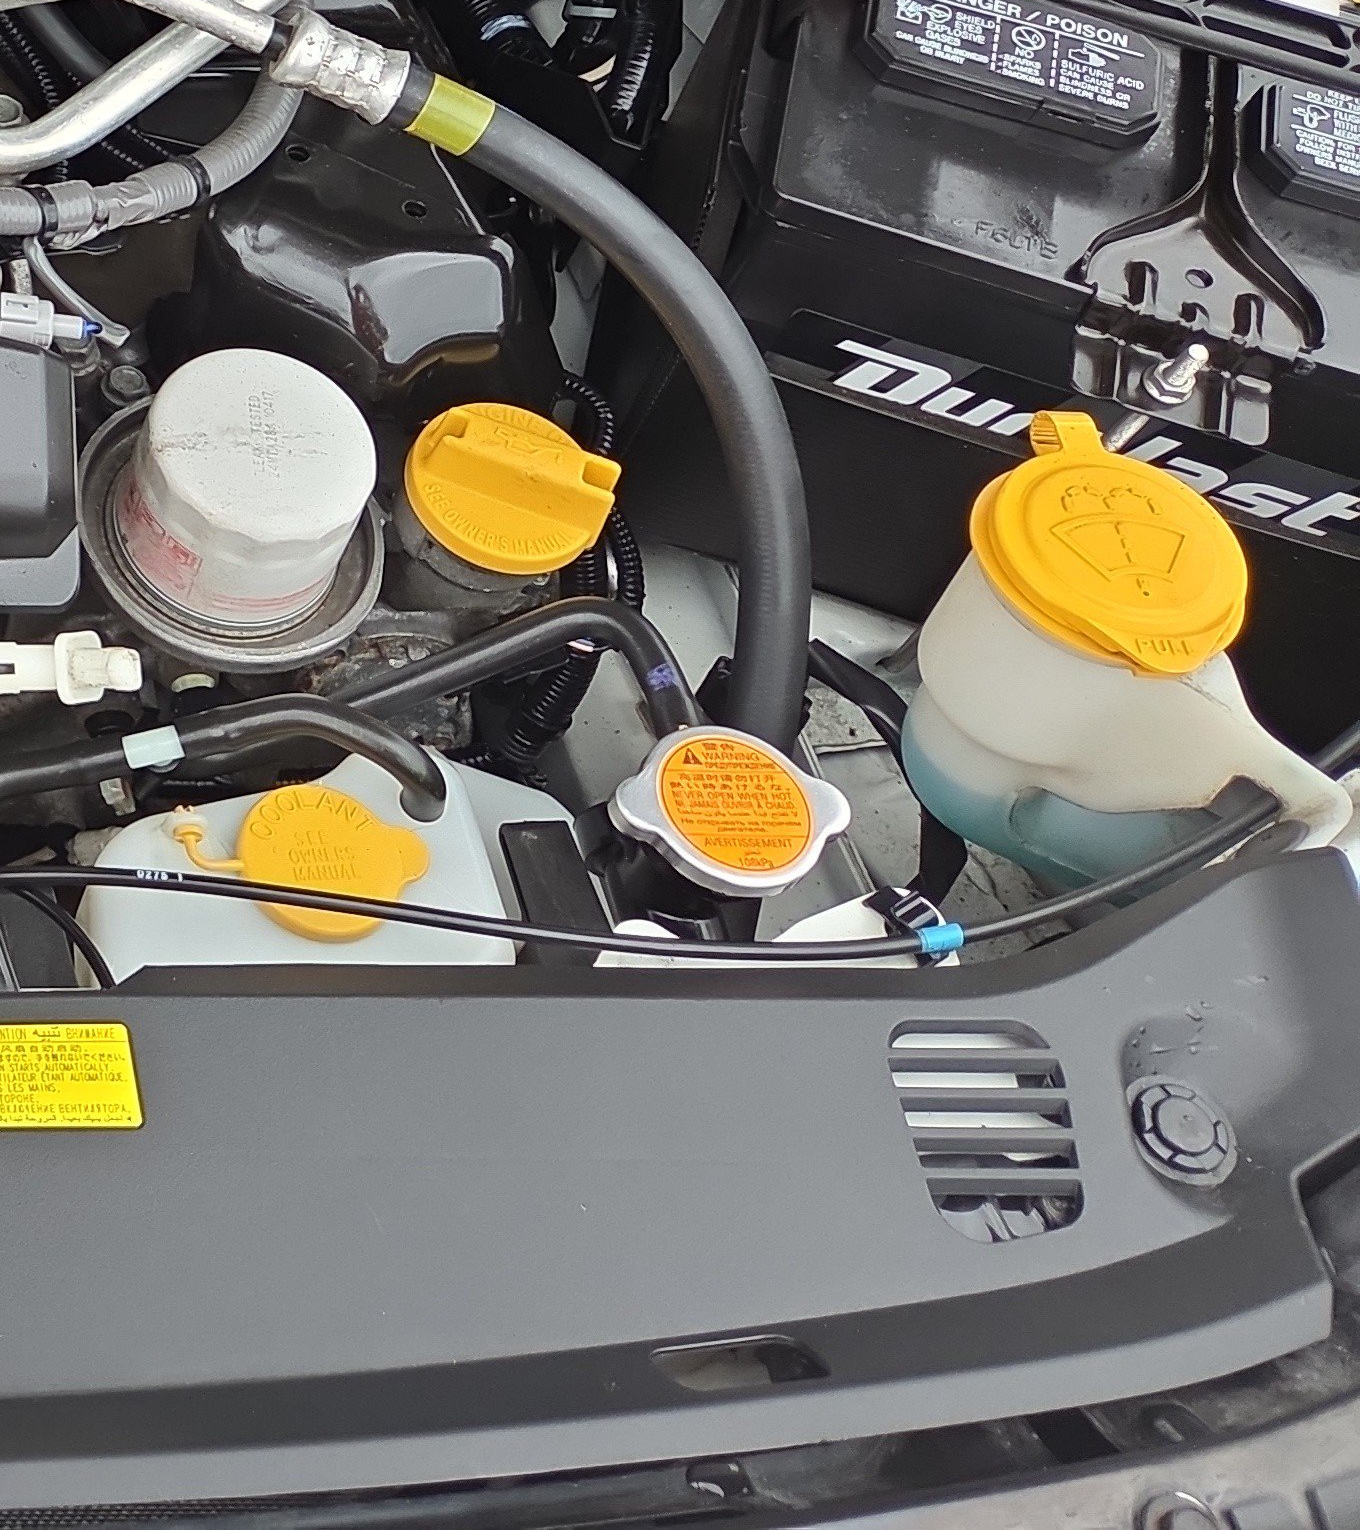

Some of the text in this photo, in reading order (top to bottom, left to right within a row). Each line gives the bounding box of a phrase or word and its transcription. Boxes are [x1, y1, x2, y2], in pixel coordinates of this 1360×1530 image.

[954, 20, 983, 34] EYES
[955, 11, 995, 30] SHIELD
[925, 30, 961, 47] GASES
[926, 21, 986, 45] EXPLOSIVE
[1045, 14, 1129, 47] POISON
[1015, 47, 1035, 59] NO
[1060, 68, 1115, 89] CAN CAUSE
[1061, 59, 1145, 91] SULFURIC ACID
[1058, 84, 1094, 100] SEVERE
[1059, 76, 1131, 101] BLINDNESS OR
[1328, 90, 1353, 101] KEEP
[1306, 91, 1321, 101] DO
[1324, 96, 1344, 108] NOT
[1333, 110, 1360, 124] FLUS
[248, 395, 262, 433] TESTED
[424, 483, 573, 556] SEE OWNER'S MANUAL
[701, 752, 759, 761] WARNING
[671, 791, 703, 799] NEVER
[708, 791, 733, 800] OPEN
[738, 792, 767, 801] WHEN
[250, 790, 373, 840] COOLANT
[294, 830, 328, 846] SEE
[704, 838, 792, 848] AVERTISSEMENT
[288, 846, 356, 864] OWNERS
[293, 863, 357, 882] MANUAL
[9, 1063, 39, 1072] STARTS
[41, 1071, 65, 1082] ÉTANT
[8, 1083, 24, 1092] LES
